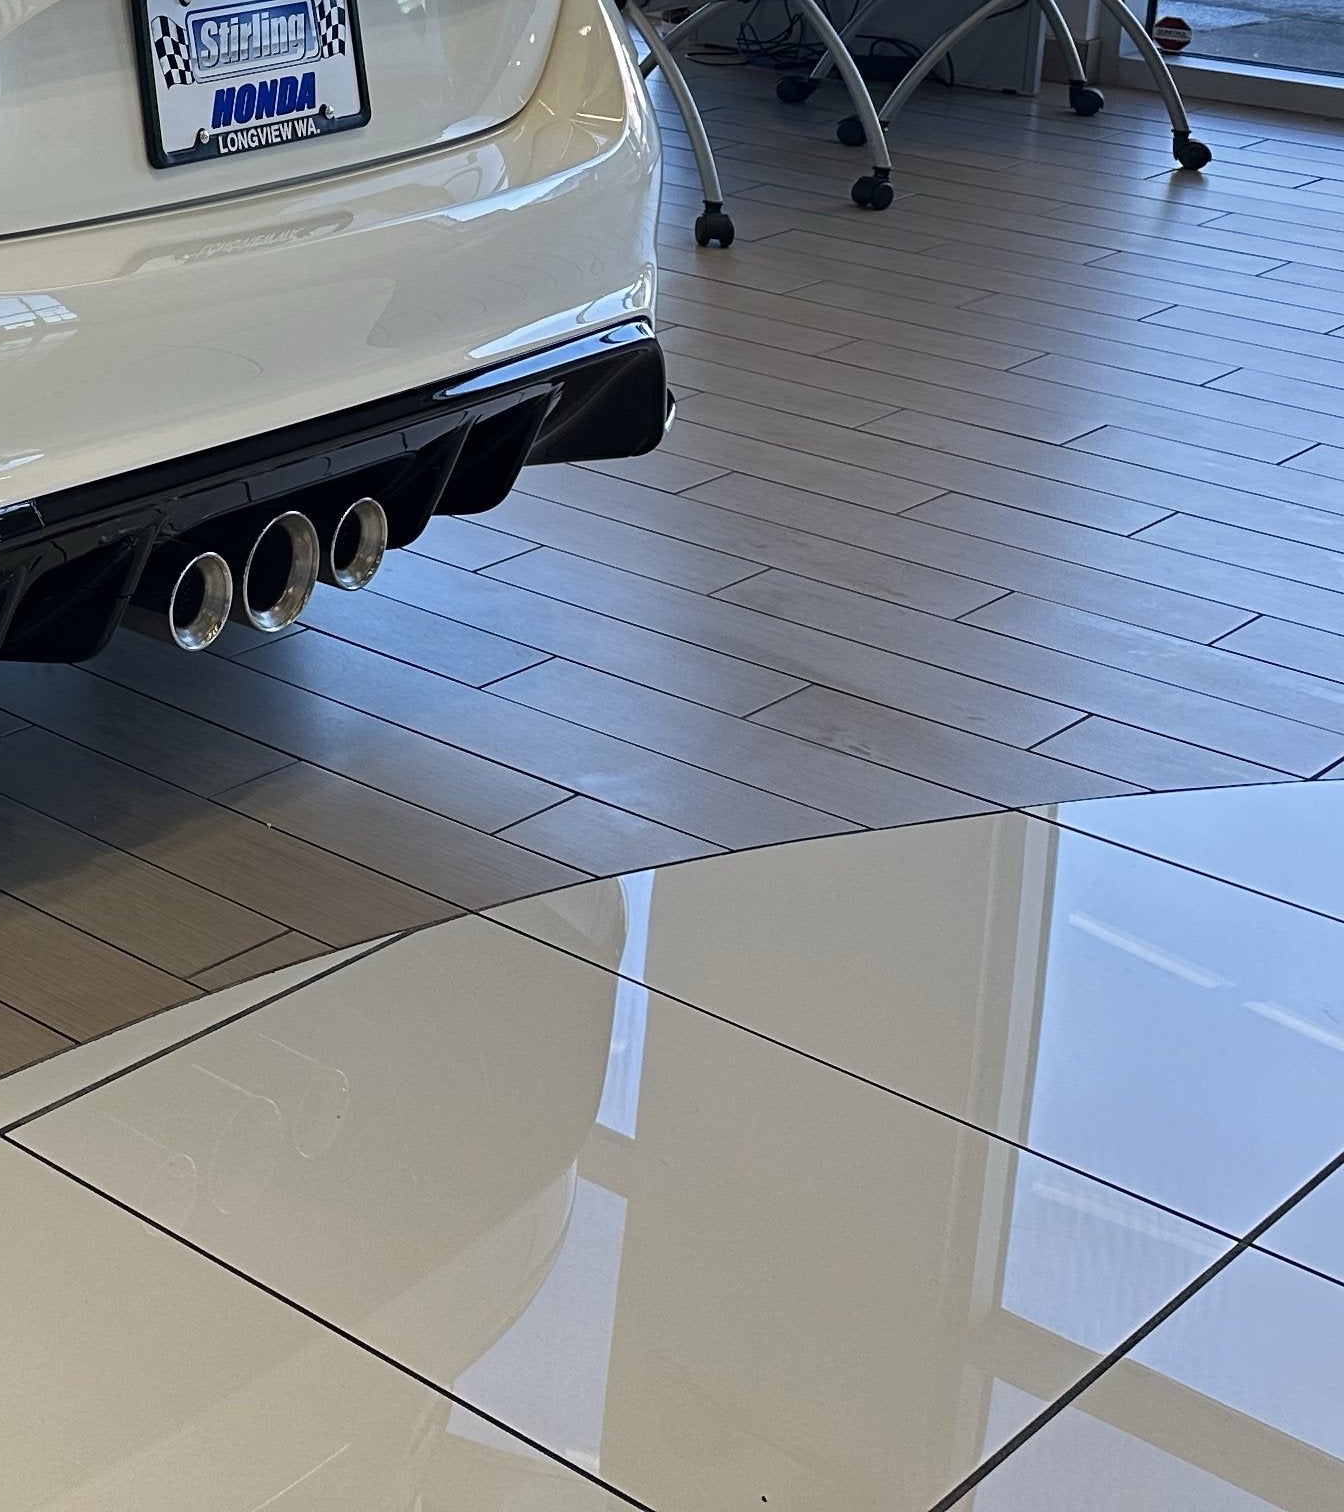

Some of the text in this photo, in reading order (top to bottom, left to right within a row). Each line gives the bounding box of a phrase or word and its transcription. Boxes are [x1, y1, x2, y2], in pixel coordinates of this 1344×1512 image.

[200, 11, 306, 68] Stirling
[211, 72, 316, 129] HONDA
[218, 117, 321, 154] LONGVIEW WA.
